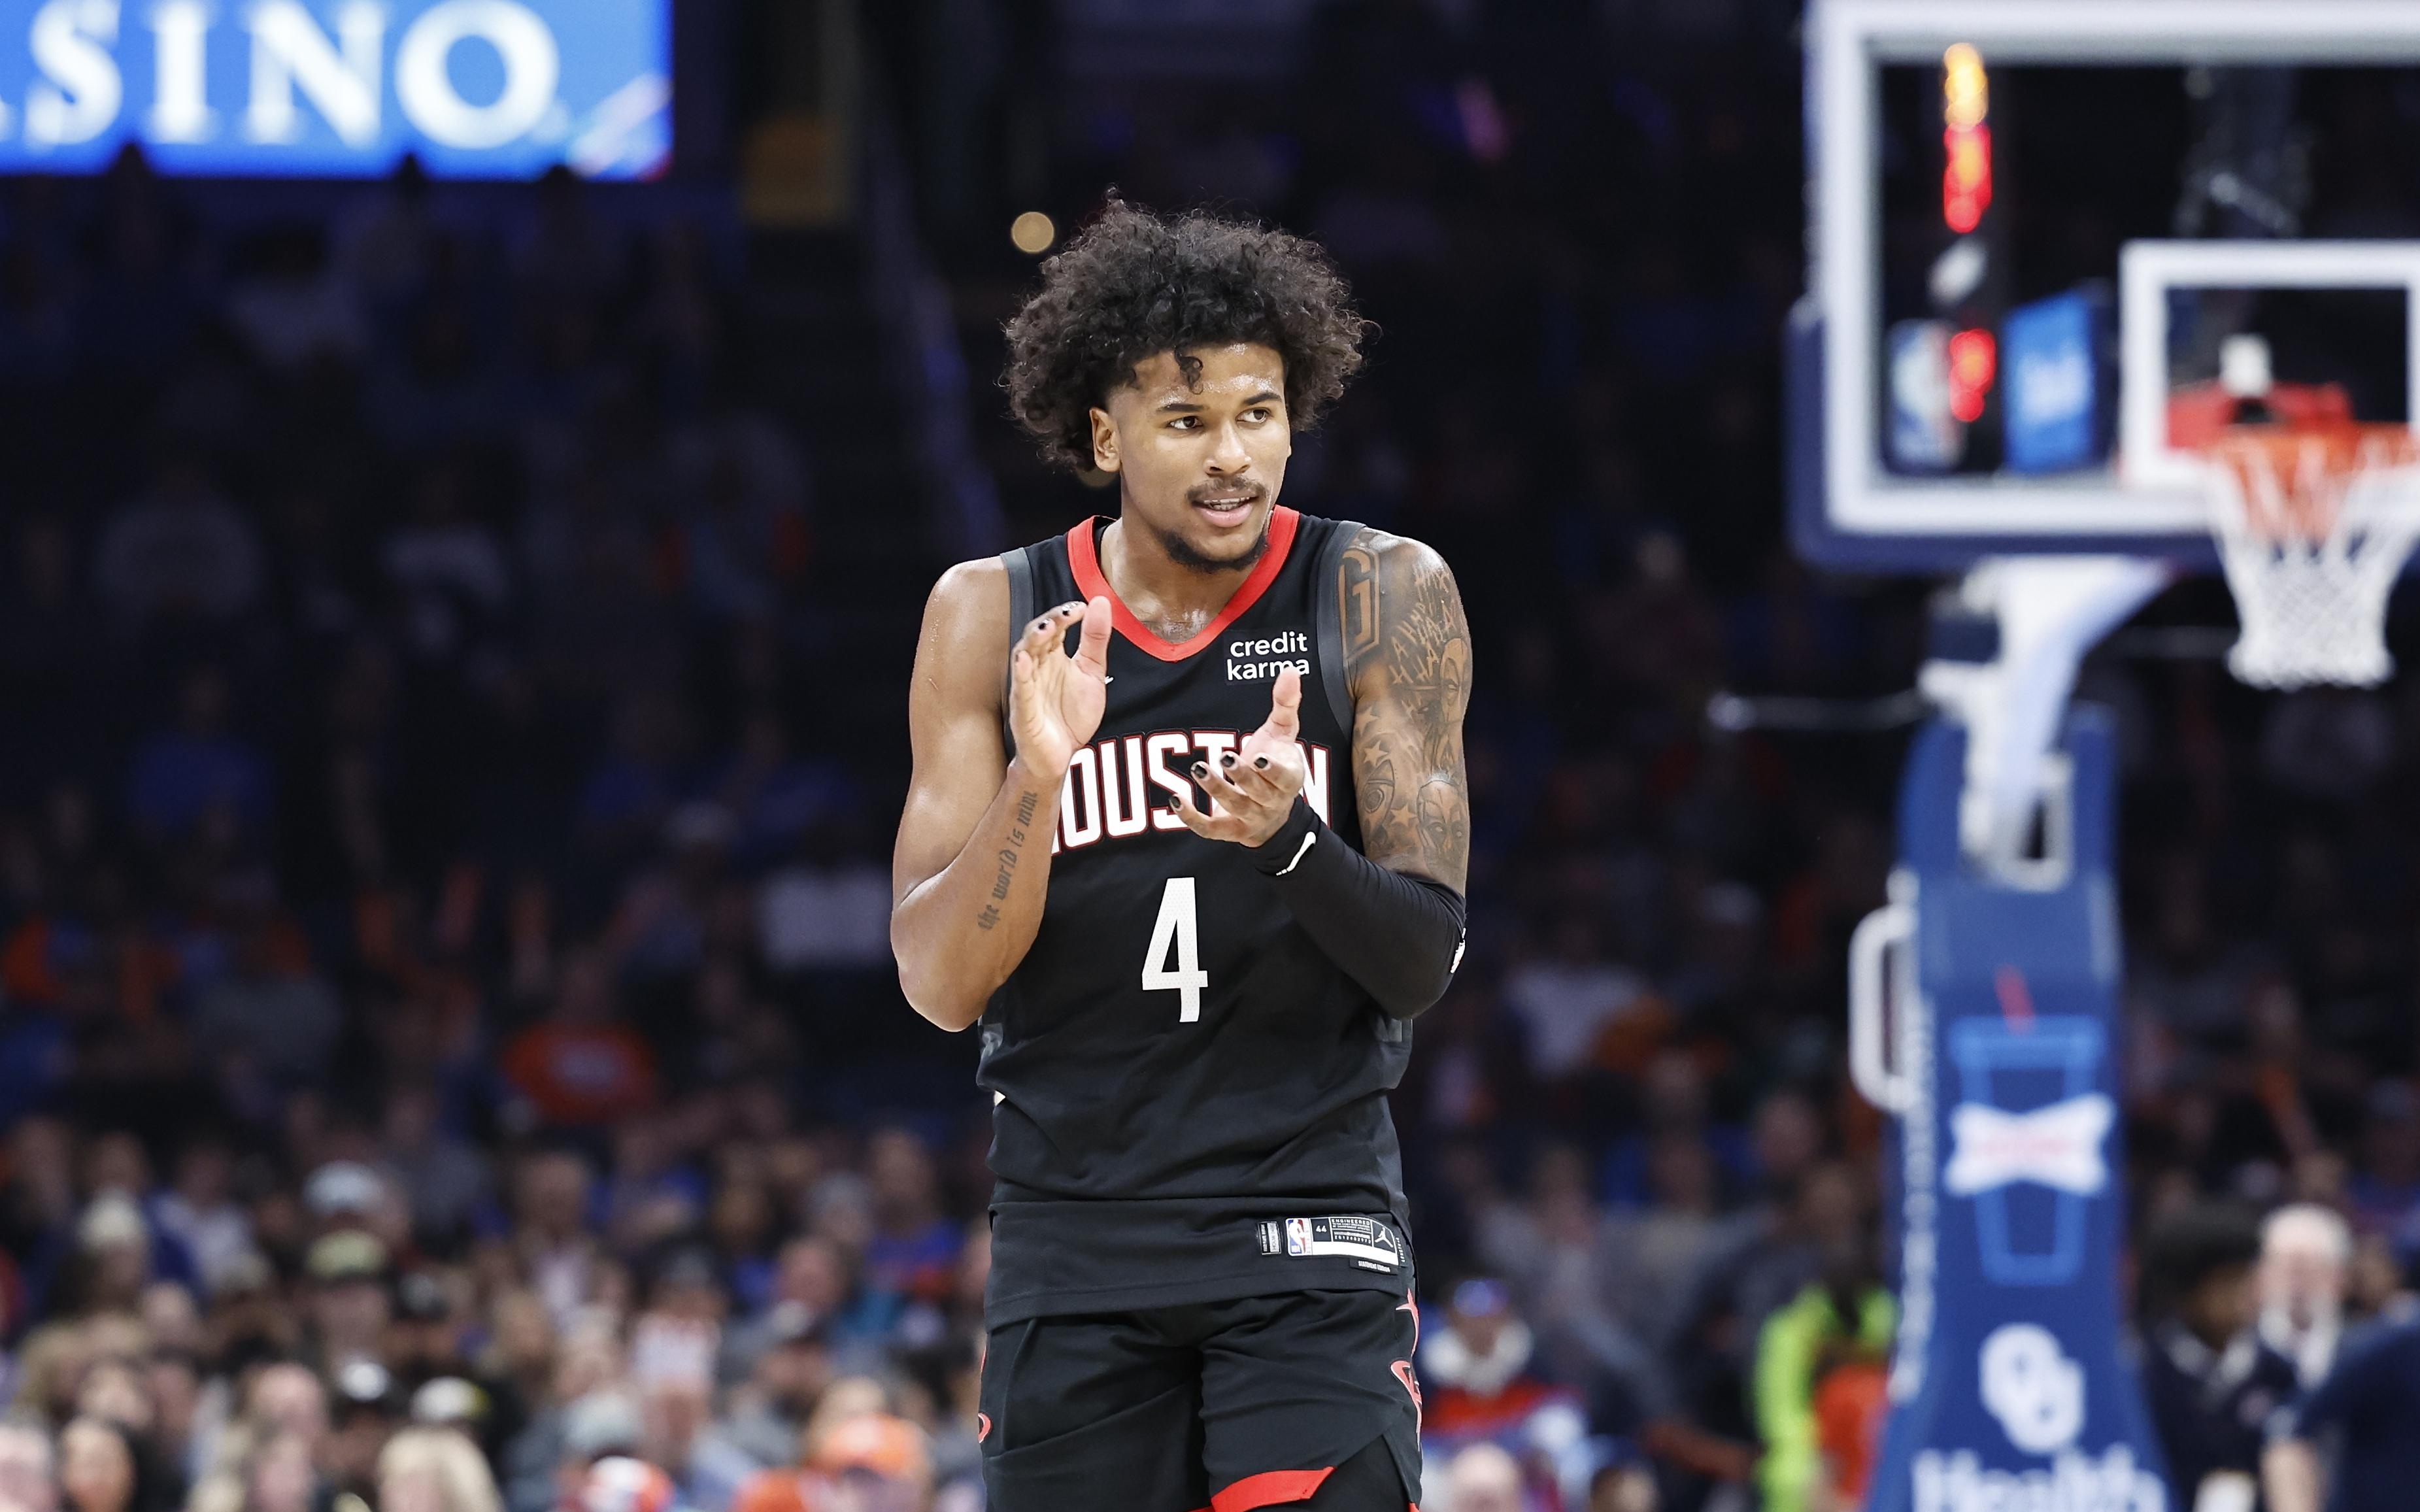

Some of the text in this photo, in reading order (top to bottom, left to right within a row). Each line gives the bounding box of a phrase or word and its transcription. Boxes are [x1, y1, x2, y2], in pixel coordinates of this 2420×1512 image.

[0, 0, 563, 149] SINO
[1226, 658, 1310, 680] karma
[1230, 631, 1308, 658] credit
[1050, 728, 1333, 857] OUSTN
[1007, 828, 1025, 848] is
[1142, 877, 1208, 1022] 4
